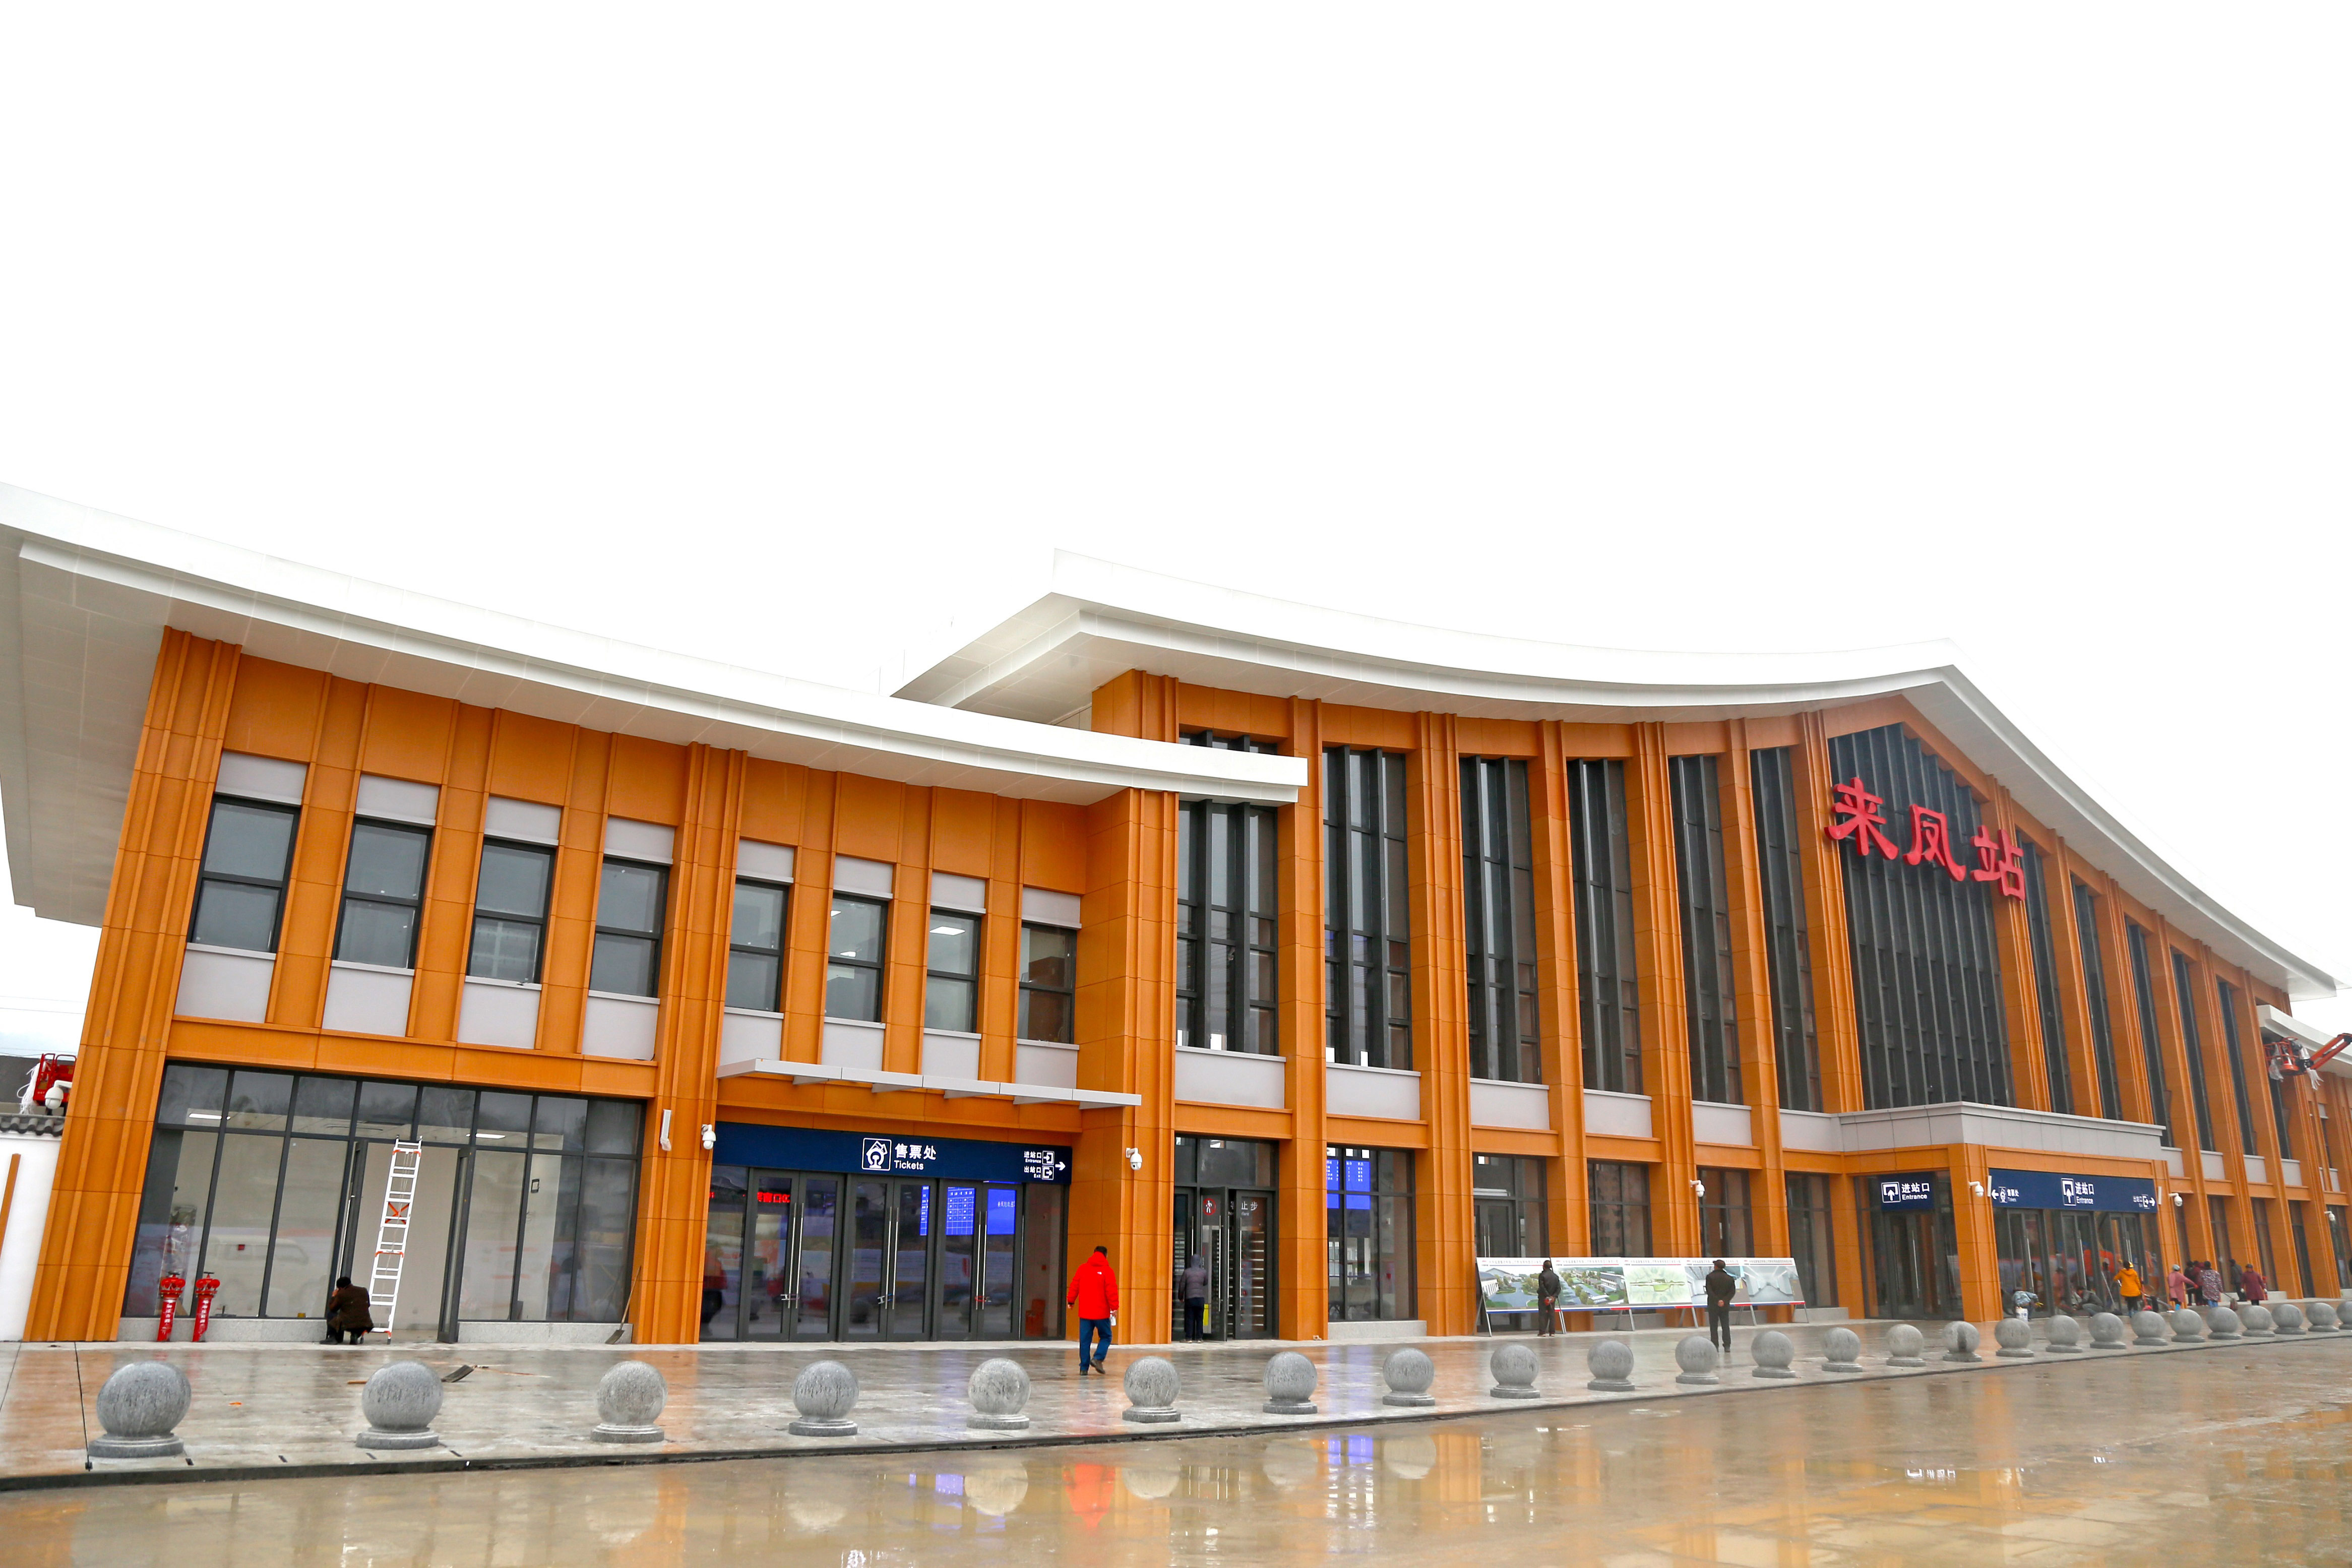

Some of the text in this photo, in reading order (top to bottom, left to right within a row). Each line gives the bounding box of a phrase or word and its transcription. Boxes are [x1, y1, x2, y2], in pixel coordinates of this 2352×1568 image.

[1824, 777, 2025, 900] 来凤站
[894, 1143, 937, 1160] 售票处
[1024, 1151, 1042, 1159] 进站口
[894, 1160, 924, 1170] Tickets
[1024, 1165, 1041, 1173] 出站口
[1901, 1182, 1930, 1194] 进站口
[2075, 1182, 2094, 1195] 进站口
